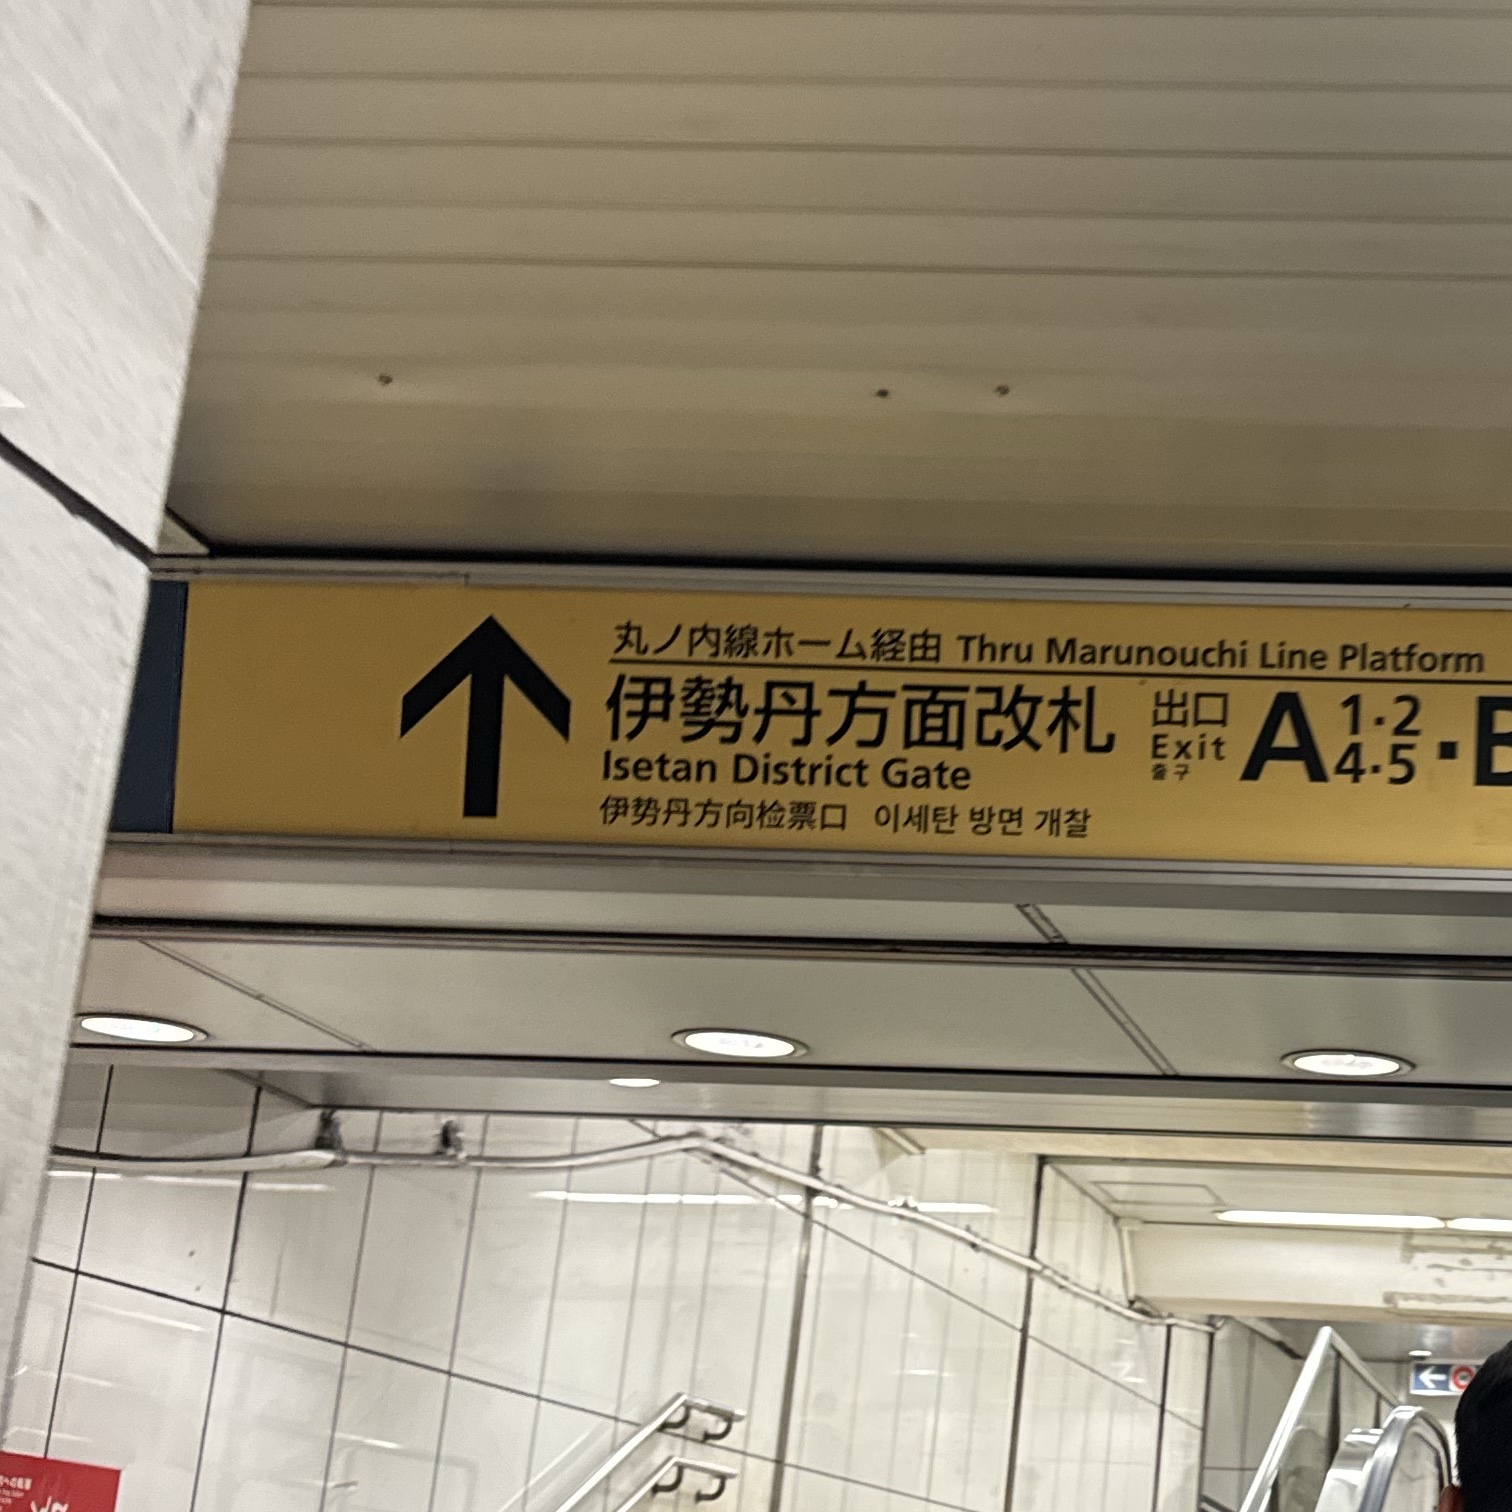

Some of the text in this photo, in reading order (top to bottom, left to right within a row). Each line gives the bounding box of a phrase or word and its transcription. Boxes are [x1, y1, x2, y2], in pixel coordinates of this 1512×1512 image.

[612, 619, 945, 664] 丸ノ内線ホーム経由
[957, 634, 1487, 675] Thru Marunouchi Line Platform
[605, 673, 1117, 754] 伊勢丹方面改札
[1152, 688, 1228, 728] 出口
[1151, 733, 1226, 761] Exit
[1239, 690, 1331, 784] A
[601, 751, 972, 791] Isetan District Gate
[599, 794, 848, 830] 伊势丹方向检票口
[873, 803, 1092, 838] 이세탄 방면 개찰
